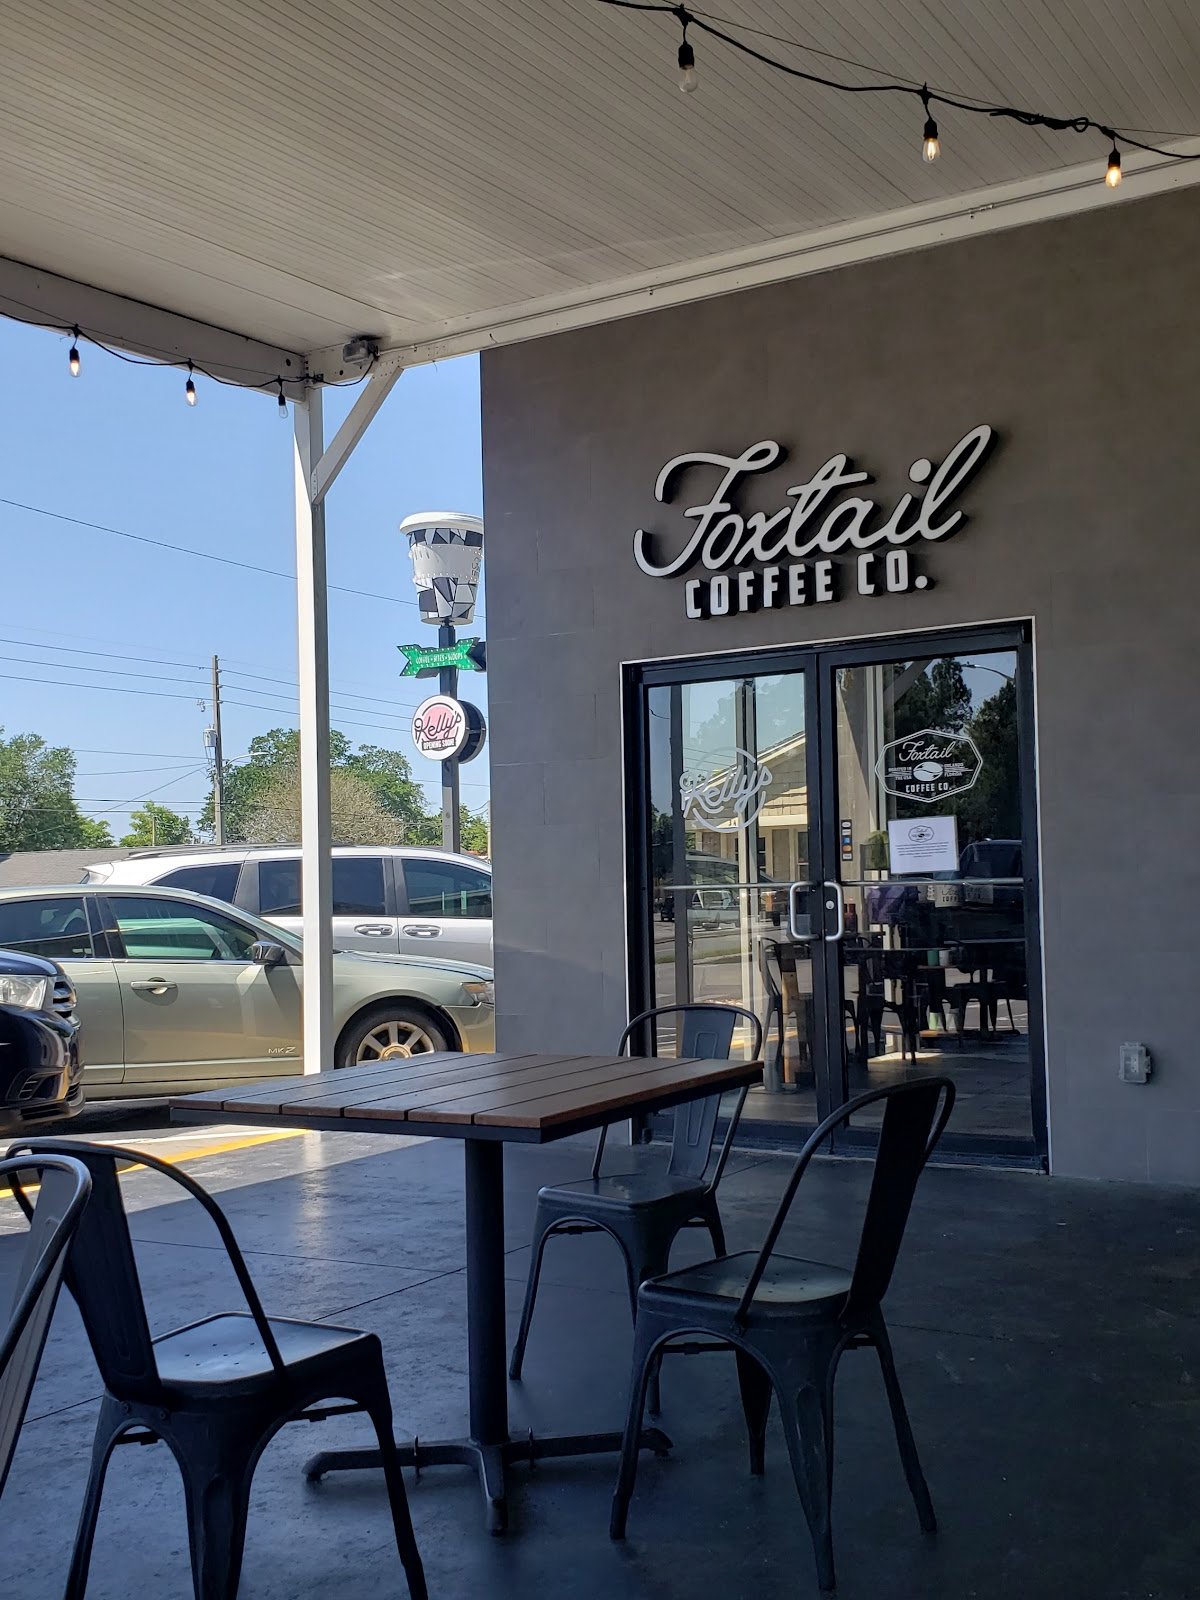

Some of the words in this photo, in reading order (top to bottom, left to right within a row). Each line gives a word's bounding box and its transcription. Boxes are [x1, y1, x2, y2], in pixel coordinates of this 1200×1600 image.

[633, 424, 992, 577] Foxtail
[685, 559, 834, 619] COFFEE
[857, 549, 929, 595] CO.
[414, 711, 462, 744] Kelly's
[899, 740, 956, 762] Foxtail
[679, 763, 773, 818] Kelly's
[905, 783, 935, 793] COFFEE
[938, 782, 952, 791] CO.
